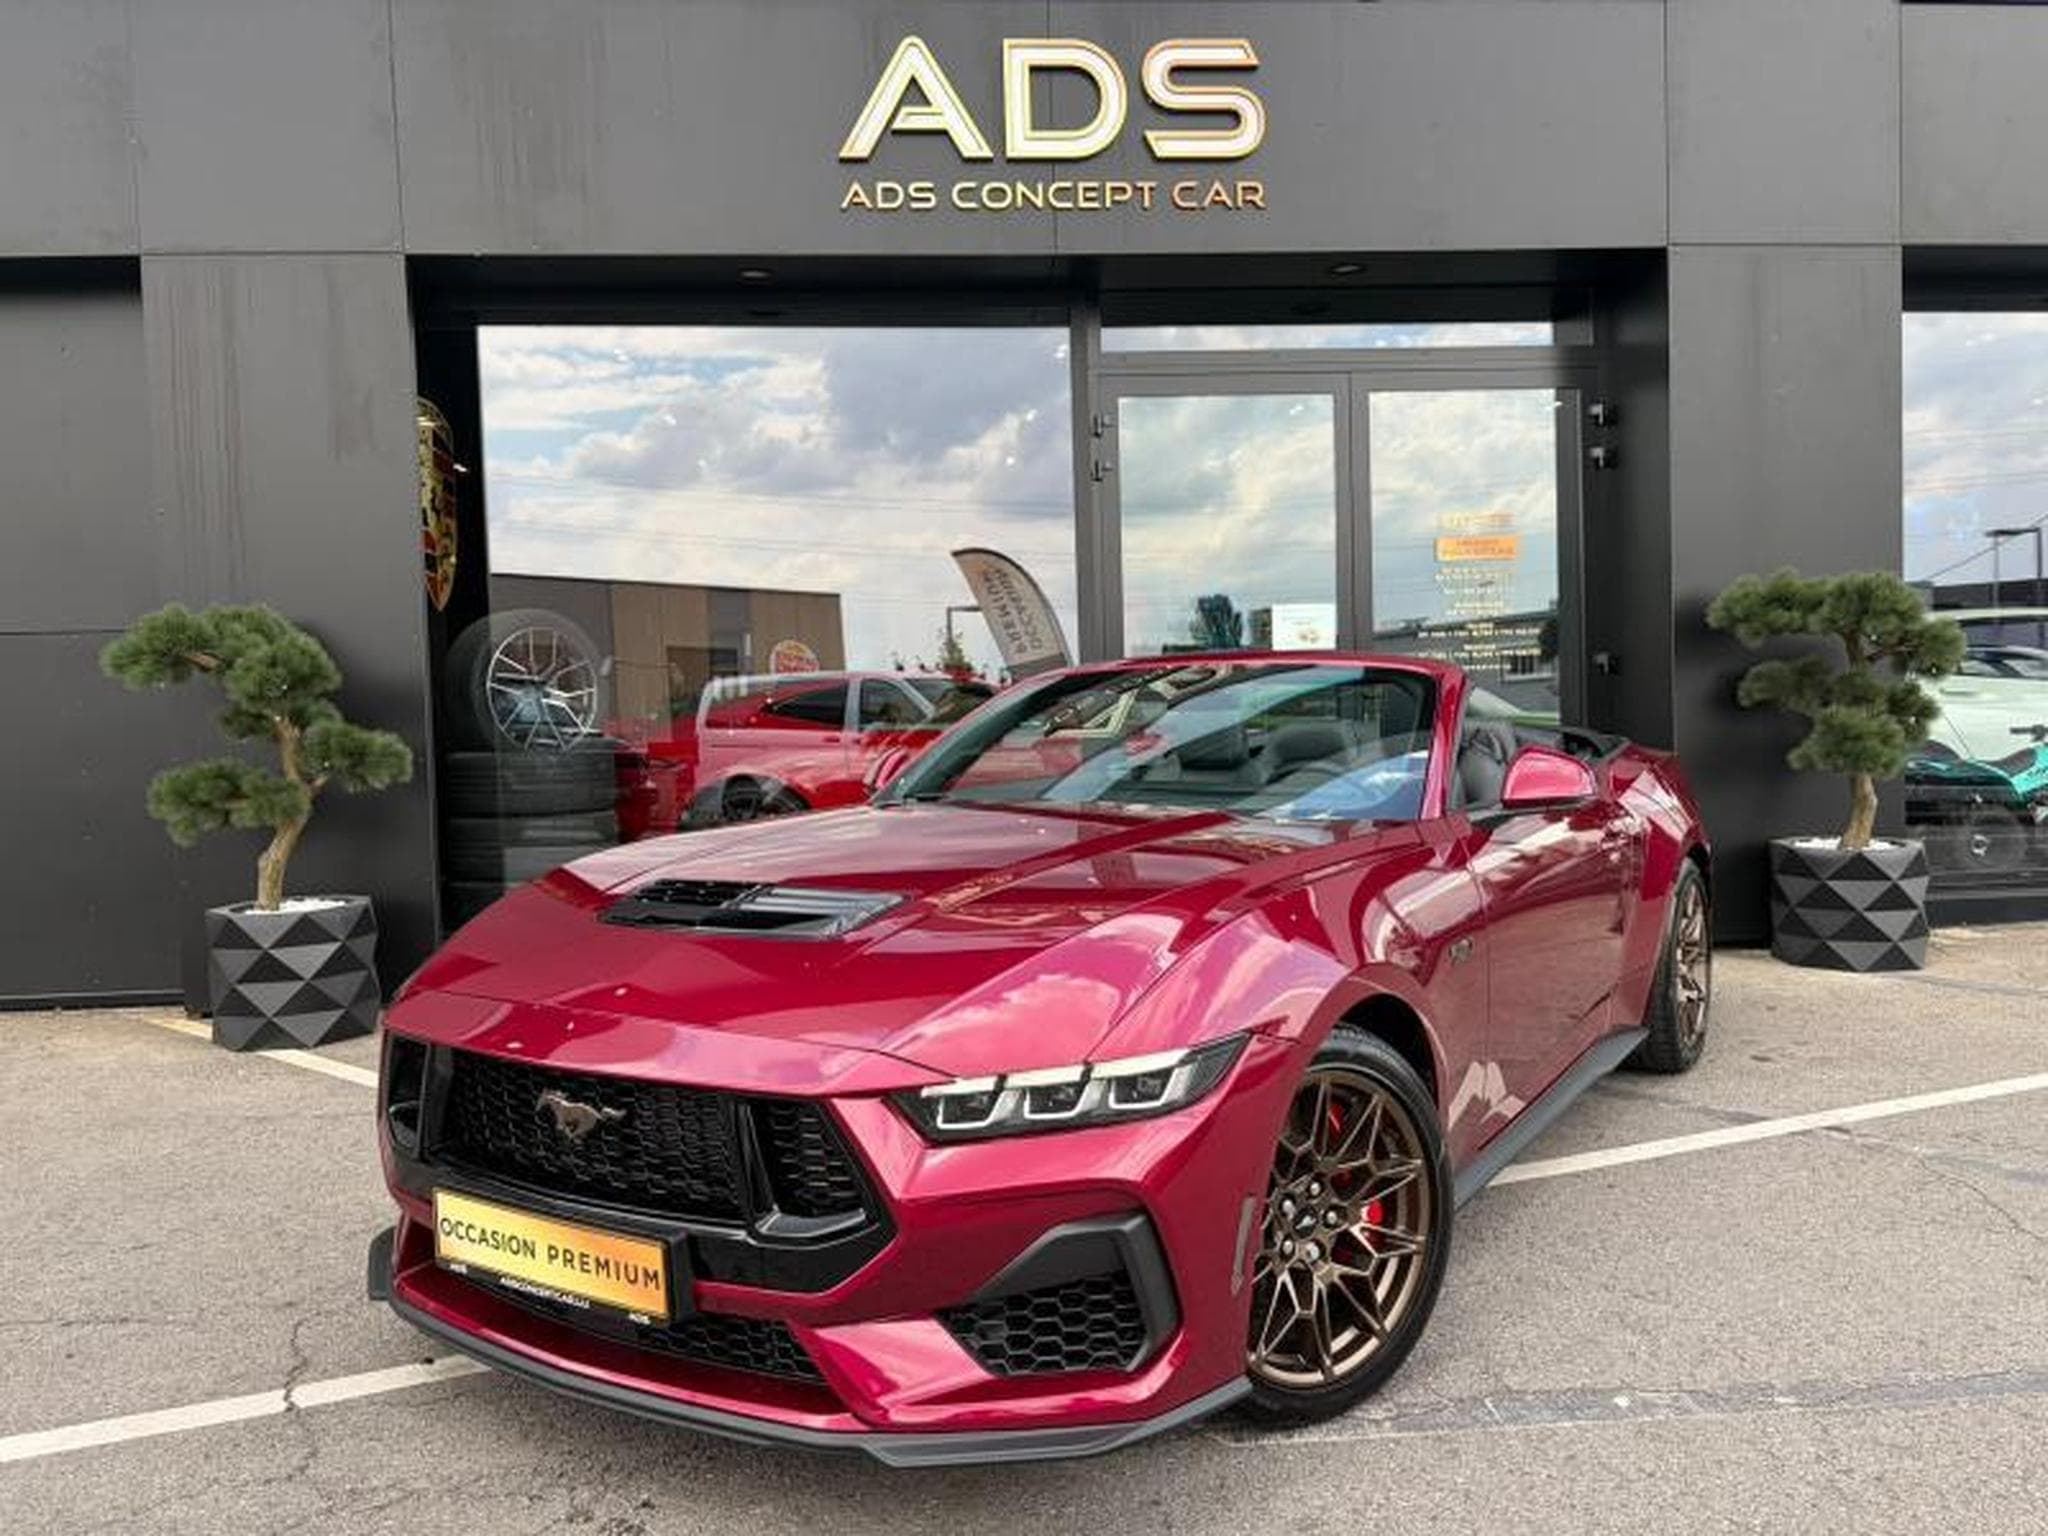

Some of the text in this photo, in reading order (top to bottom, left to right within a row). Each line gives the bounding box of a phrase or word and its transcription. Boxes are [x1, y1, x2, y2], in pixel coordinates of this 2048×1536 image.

[839, 35, 1266, 162] ADS
[841, 181, 1266, 211] ADS CONCEPT CAR
[439, 1217, 661, 1291] OCCASION PREMIUM
